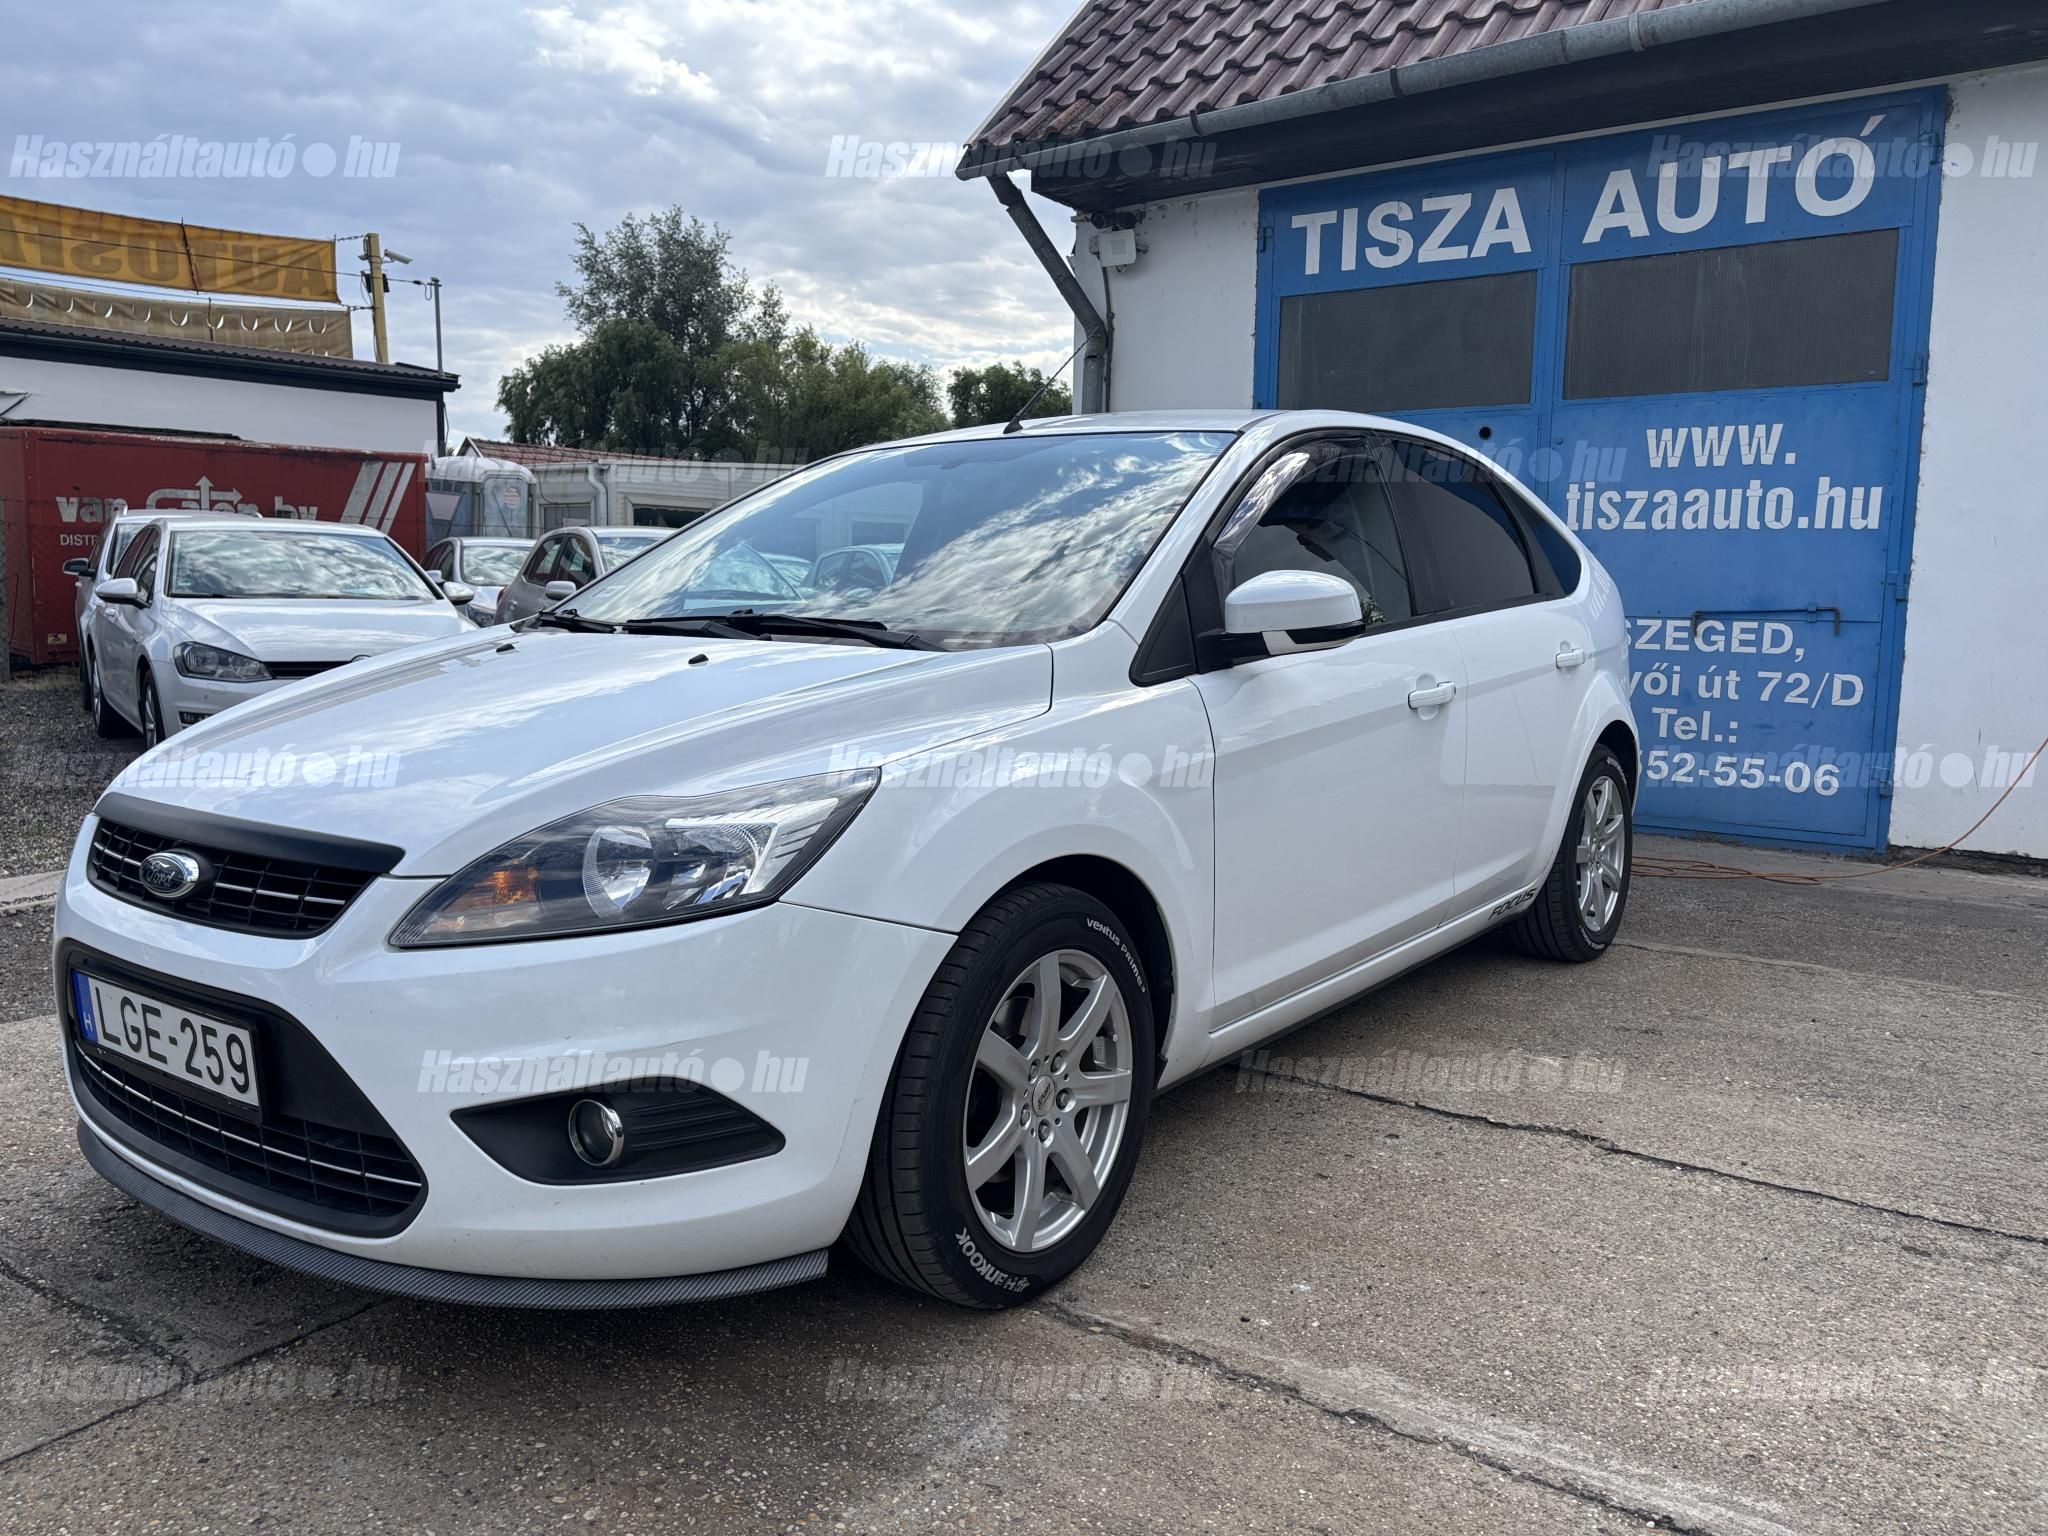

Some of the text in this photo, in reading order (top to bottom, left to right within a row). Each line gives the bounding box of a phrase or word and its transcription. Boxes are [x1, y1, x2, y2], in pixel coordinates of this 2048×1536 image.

[1291, 115, 1886, 275] TISZA AUTÓ
[1565, 476, 1883, 531] tiszaauto.hu
[1624, 618, 1806, 663] ZEGED,
[1697, 664, 1740, 701] út
[1757, 671, 1865, 709] 72/D
[1651, 706, 1739, 744] Tel.:
[1639, 749, 1841, 797] 52-55-06
[146, 859, 176, 888] Ford
[1488, 887, 1538, 921] FOCUS
[82, 1011, 94, 1033] H
[95, 986, 250, 1094] LGE-259
